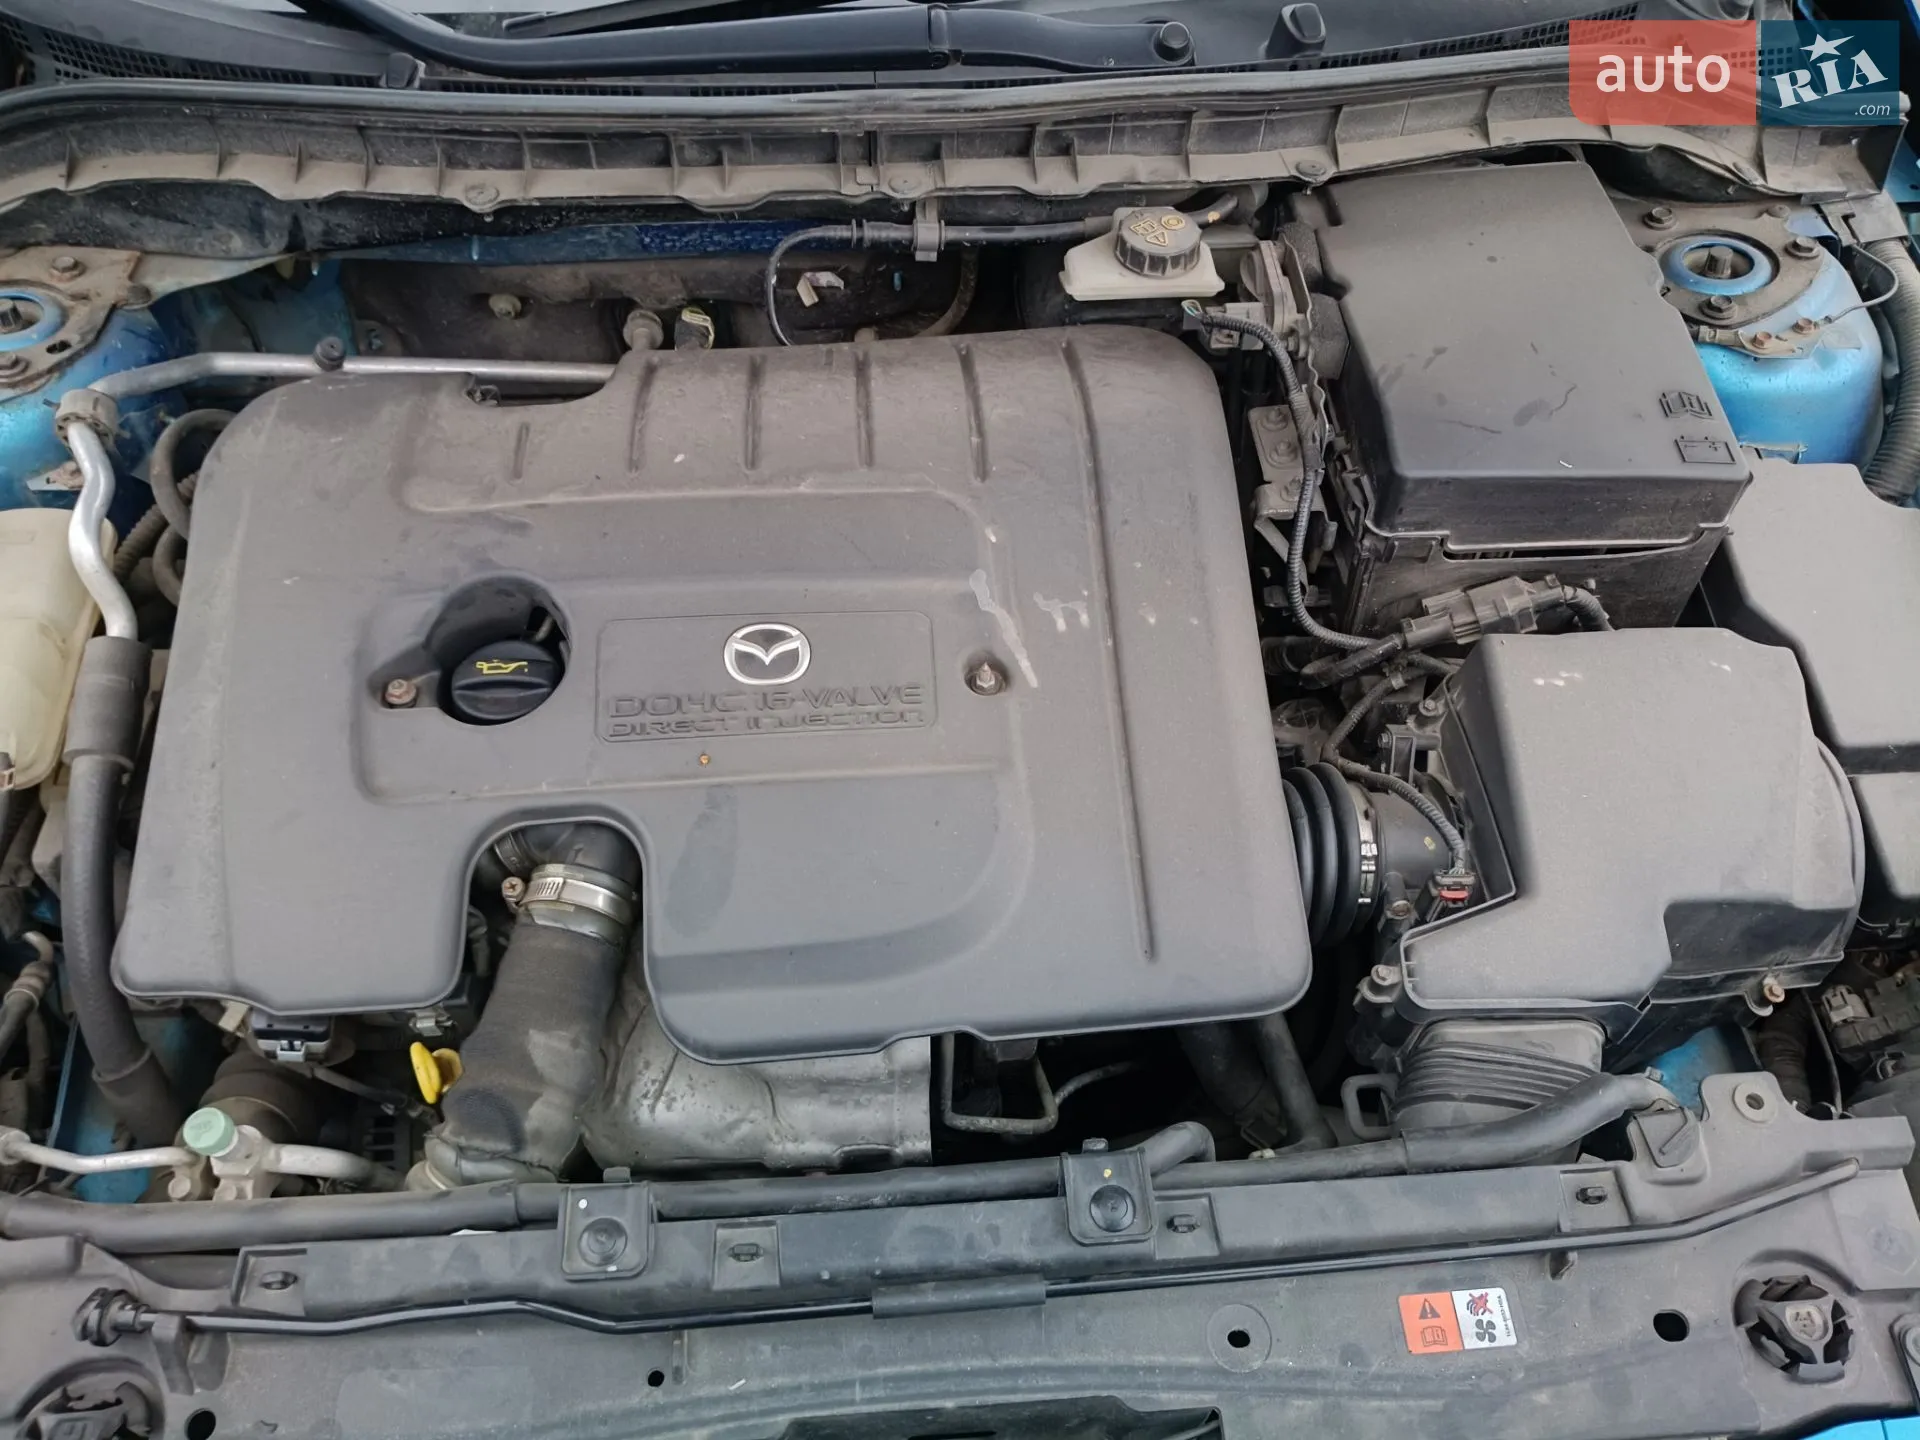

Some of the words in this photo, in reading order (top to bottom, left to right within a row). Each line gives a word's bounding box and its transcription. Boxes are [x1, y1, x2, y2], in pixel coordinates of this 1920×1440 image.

[609, 691, 748, 718] DOHC
[608, 717, 729, 738] DIRECT
[746, 709, 925, 730] INJECTION
